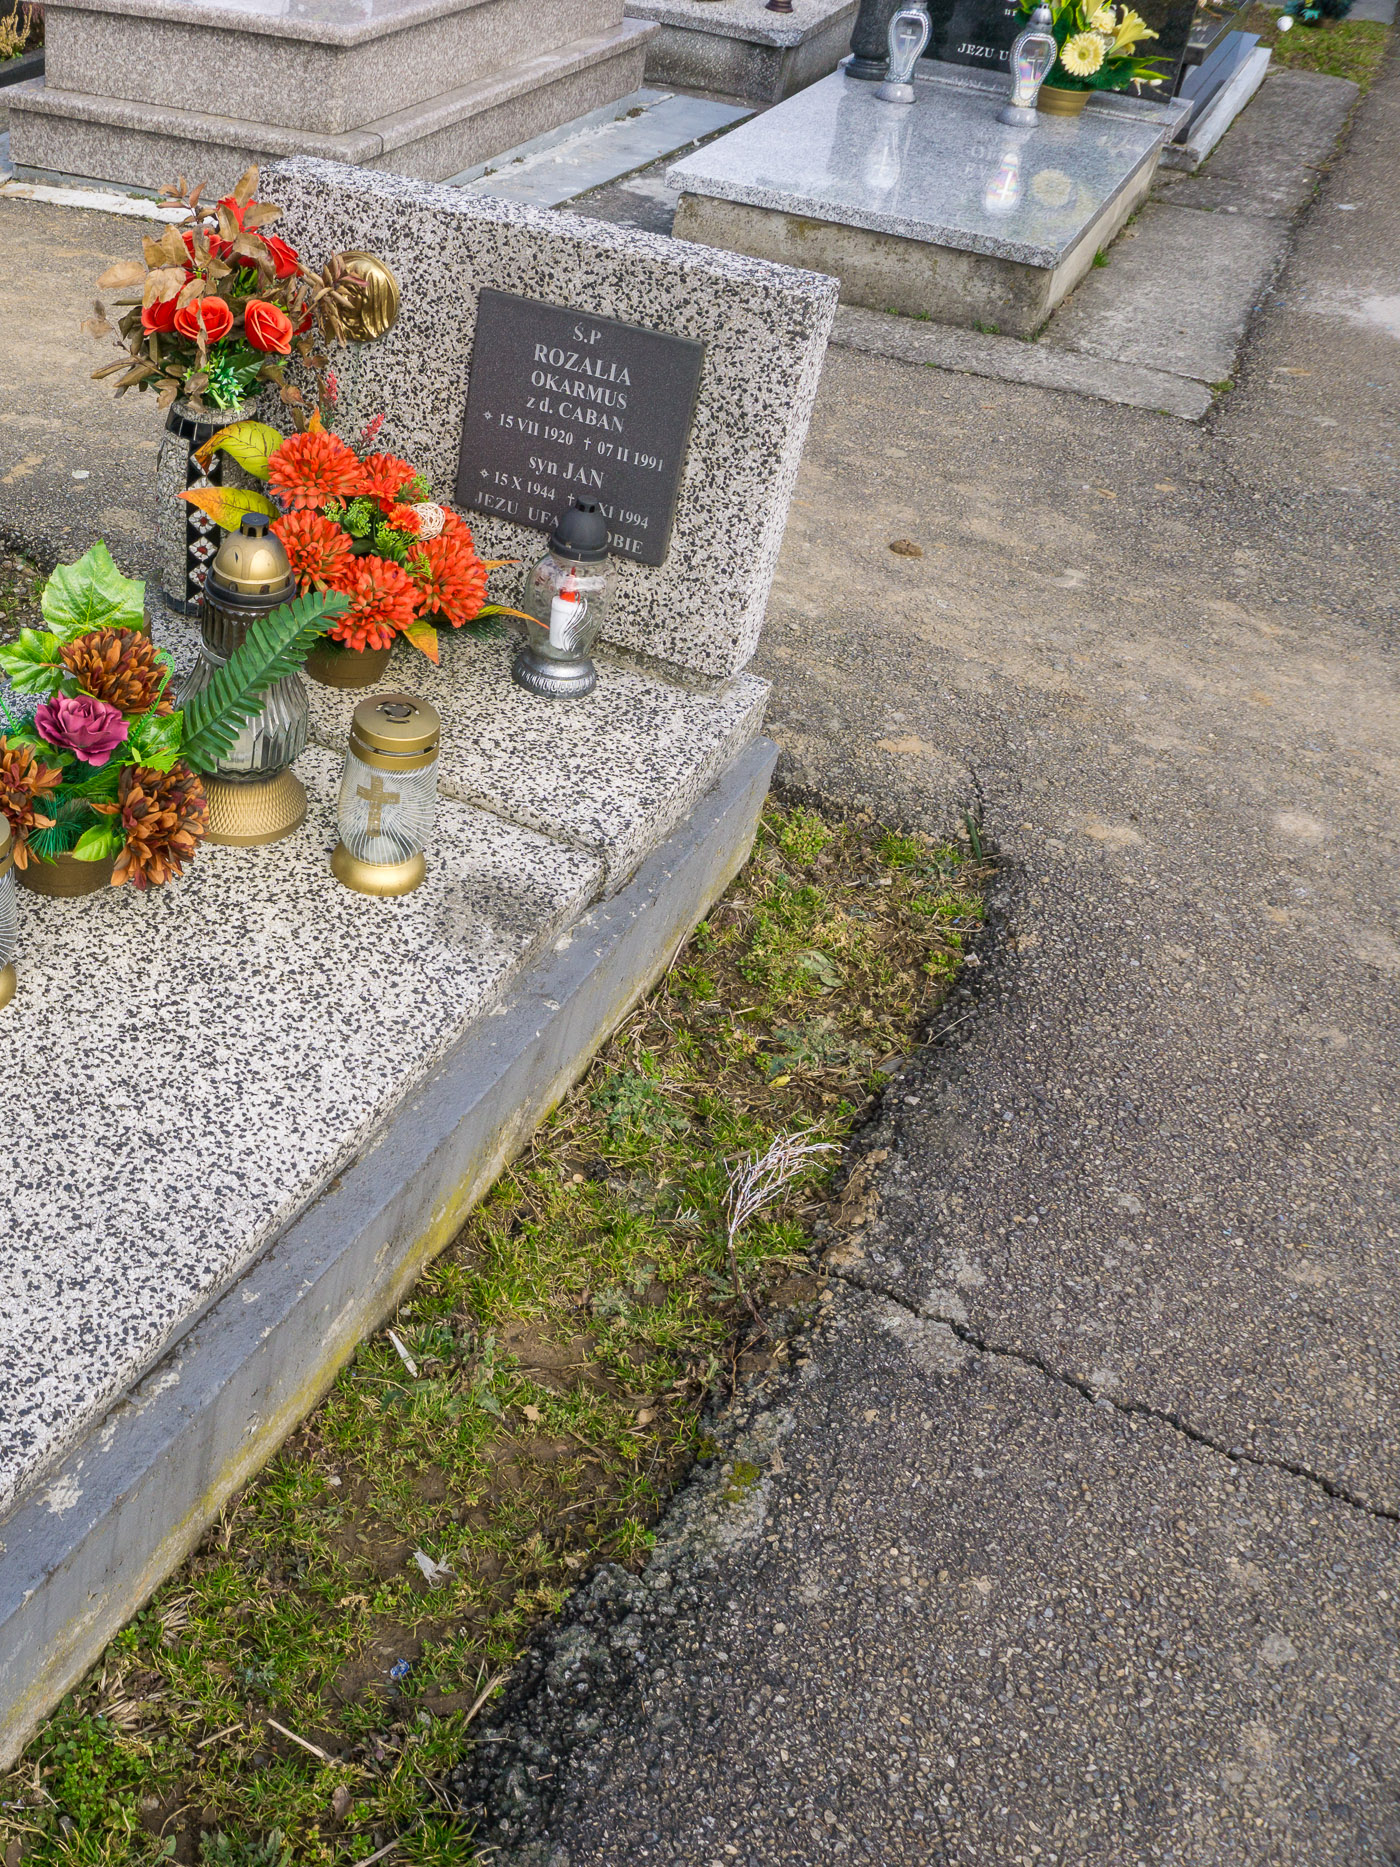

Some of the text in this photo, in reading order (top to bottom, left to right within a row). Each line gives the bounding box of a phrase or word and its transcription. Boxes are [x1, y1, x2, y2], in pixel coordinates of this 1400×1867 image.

[957, 43, 995, 58] JEZU
[533, 343, 631, 386] ROZALIA
[531, 370, 628, 410] OKARMUS
[558, 402, 625, 433] CABAN
[499, 413, 664, 472] 15 VII 1920 07 II 1991
[529, 456, 605, 489] syn JAN
[494, 471, 508, 486] 15
[511, 476, 523, 491] X
[527, 481, 556, 501] 1944
[619, 509, 649, 529] 1994
[474, 491, 644, 555] JEZU UFA BIE
